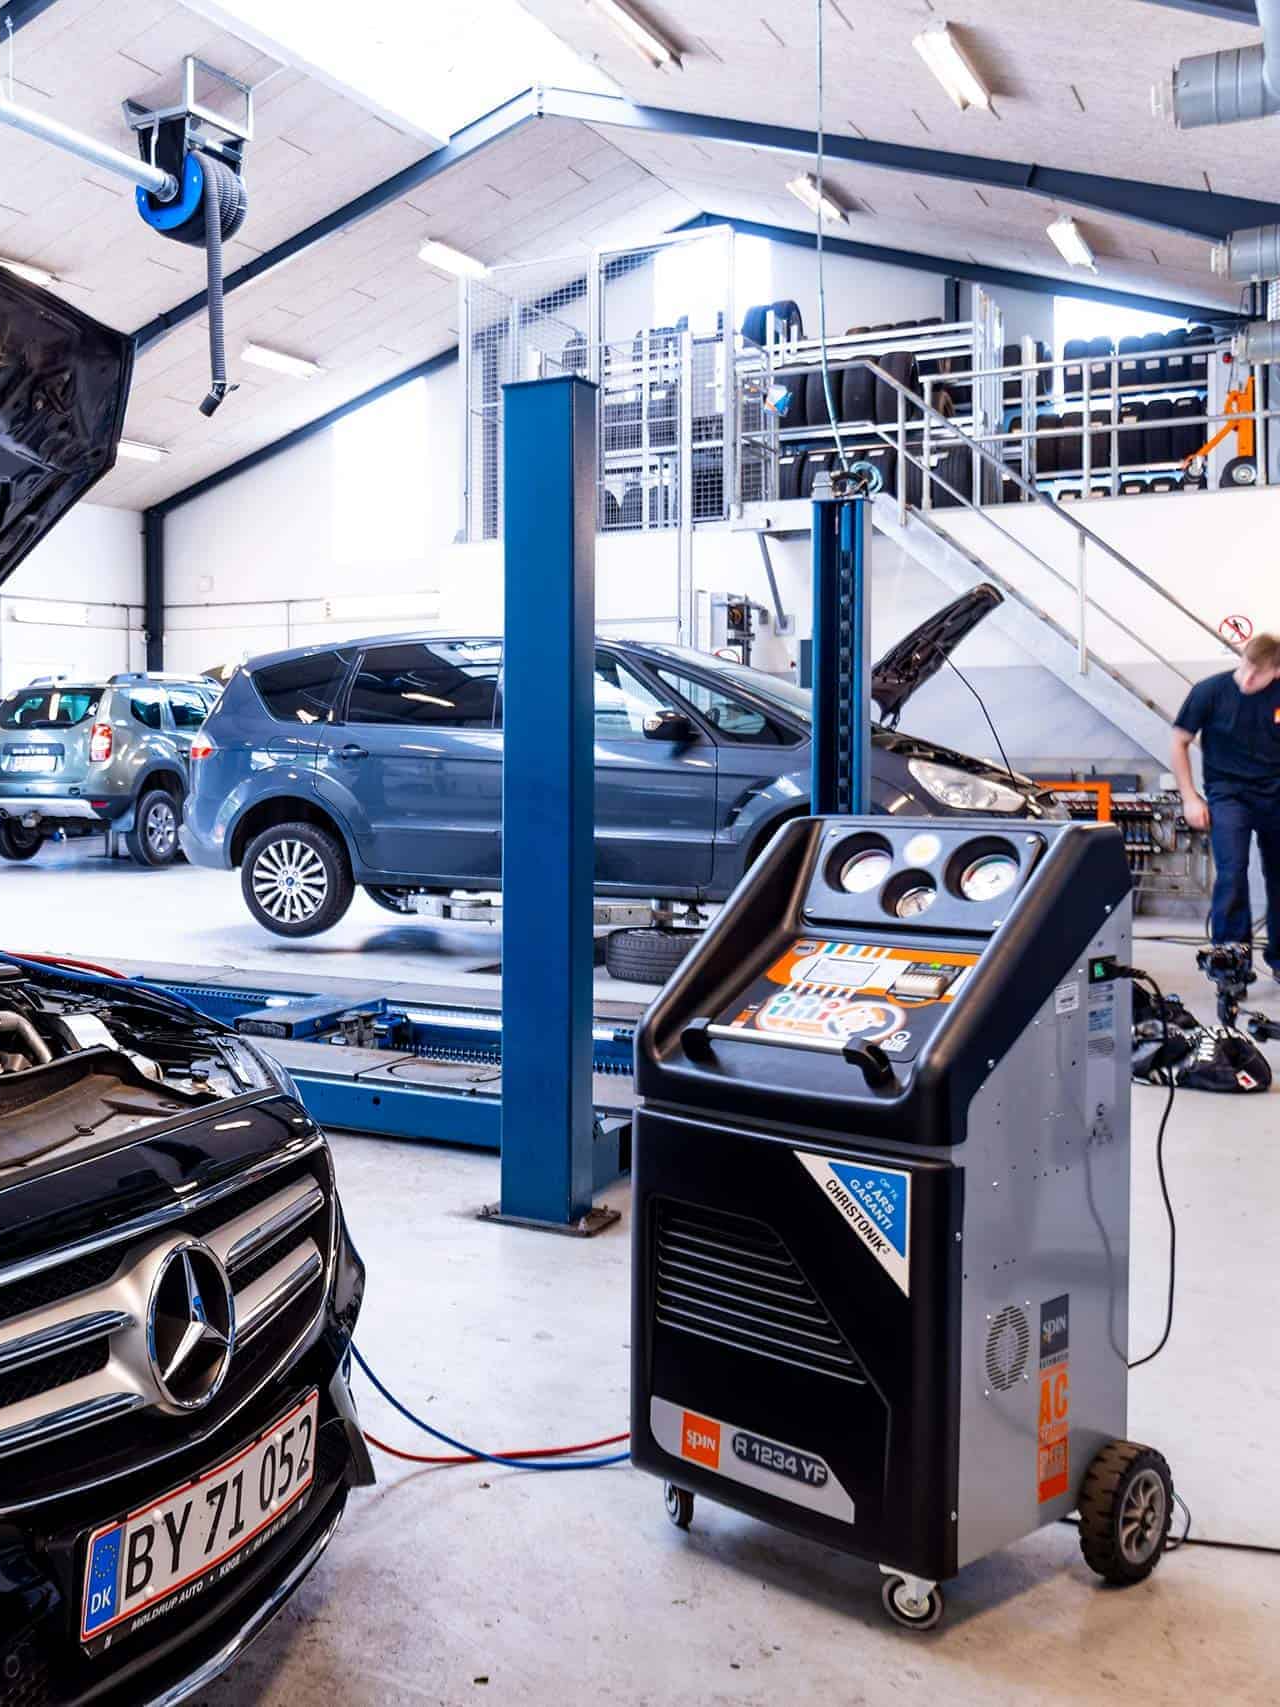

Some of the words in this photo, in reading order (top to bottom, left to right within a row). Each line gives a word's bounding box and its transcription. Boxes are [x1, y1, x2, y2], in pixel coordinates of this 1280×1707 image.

[850, 1179, 893, 1230] GARANTI
[865, 1180, 875, 1190] 5
[825, 1179, 887, 1254] CHRISTONIK
[1039, 1373, 1069, 1426] AC
[735, 1437, 748, 1456] R
[751, 1442, 798, 1475] 1234
[801, 1459, 827, 1483] YF
[125, 1501, 193, 1600] BY
[204, 1470, 245, 1555] 71
[259, 1413, 312, 1512] 052
[90, 1586, 112, 1615] DK
[178, 1580, 204, 1606] AUTO
